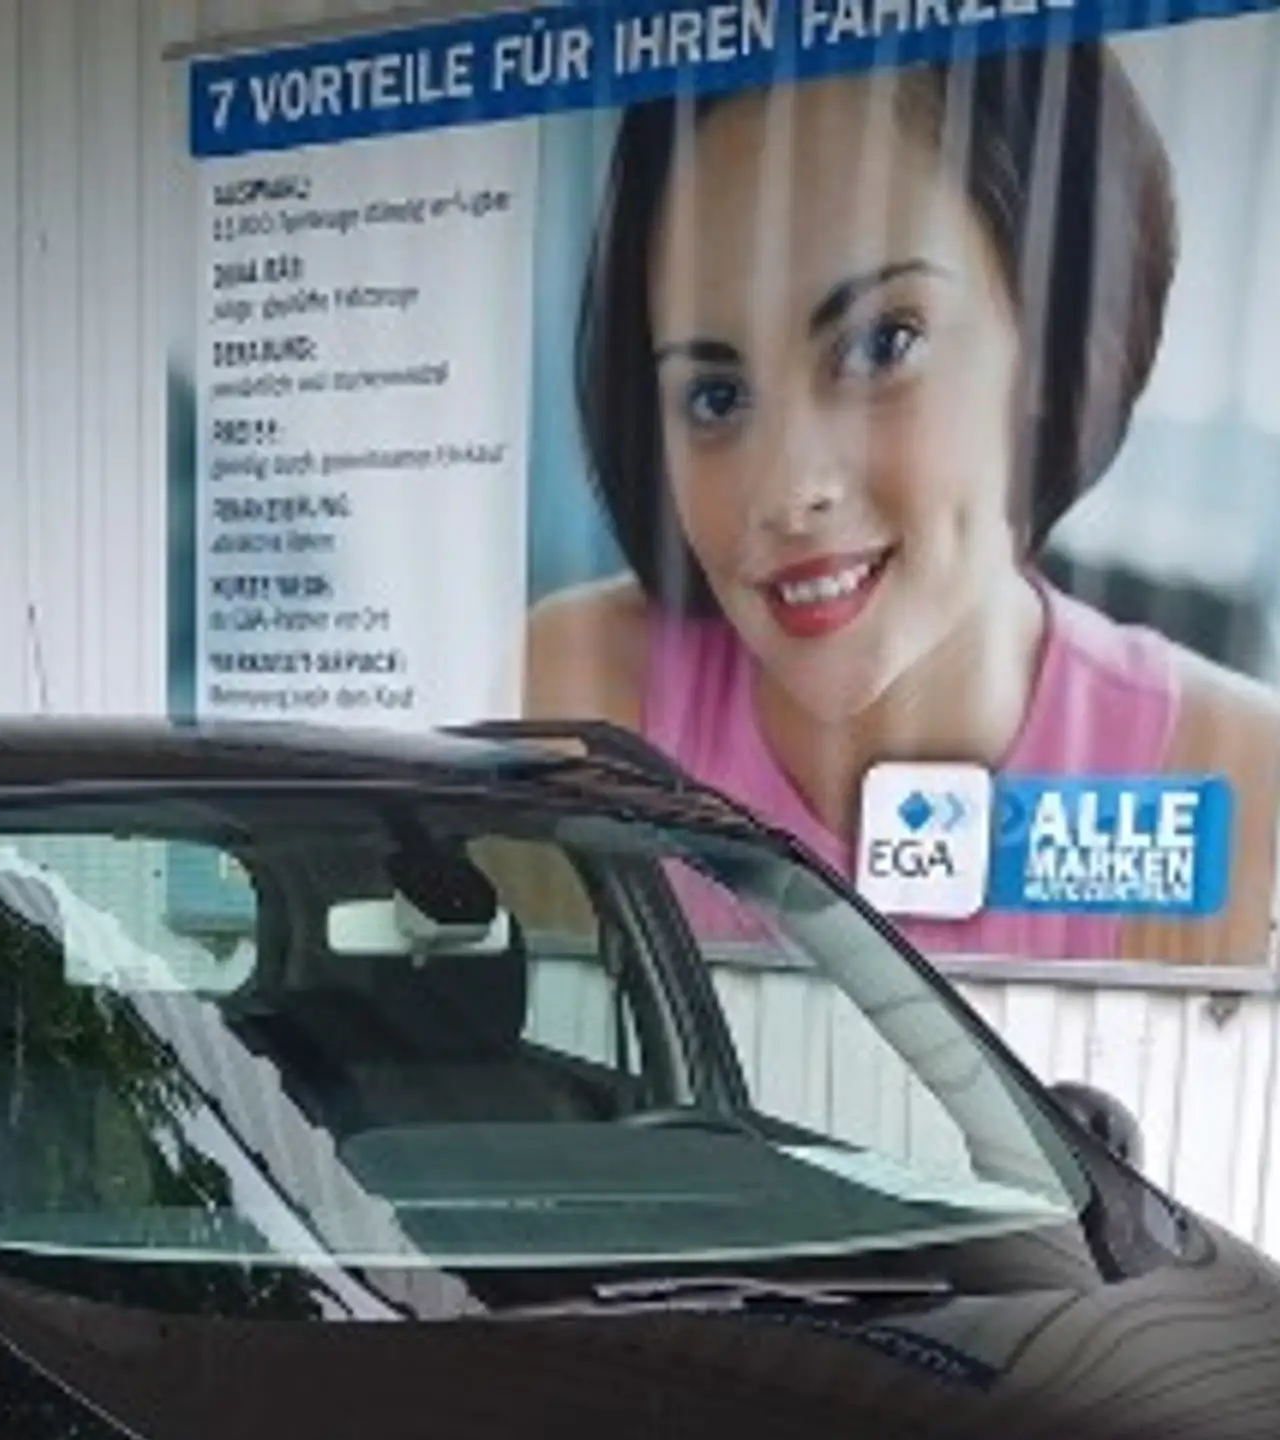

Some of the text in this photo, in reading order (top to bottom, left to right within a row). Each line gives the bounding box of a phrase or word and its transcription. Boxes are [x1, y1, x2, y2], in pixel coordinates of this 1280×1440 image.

[208, 0, 1074, 132] 7 VORTEILE FÜR IHREN FAHR
[1029, 791, 1199, 849] ALLE
[868, 837, 955, 879] EGA
[1027, 846, 1194, 882] MARKEN
